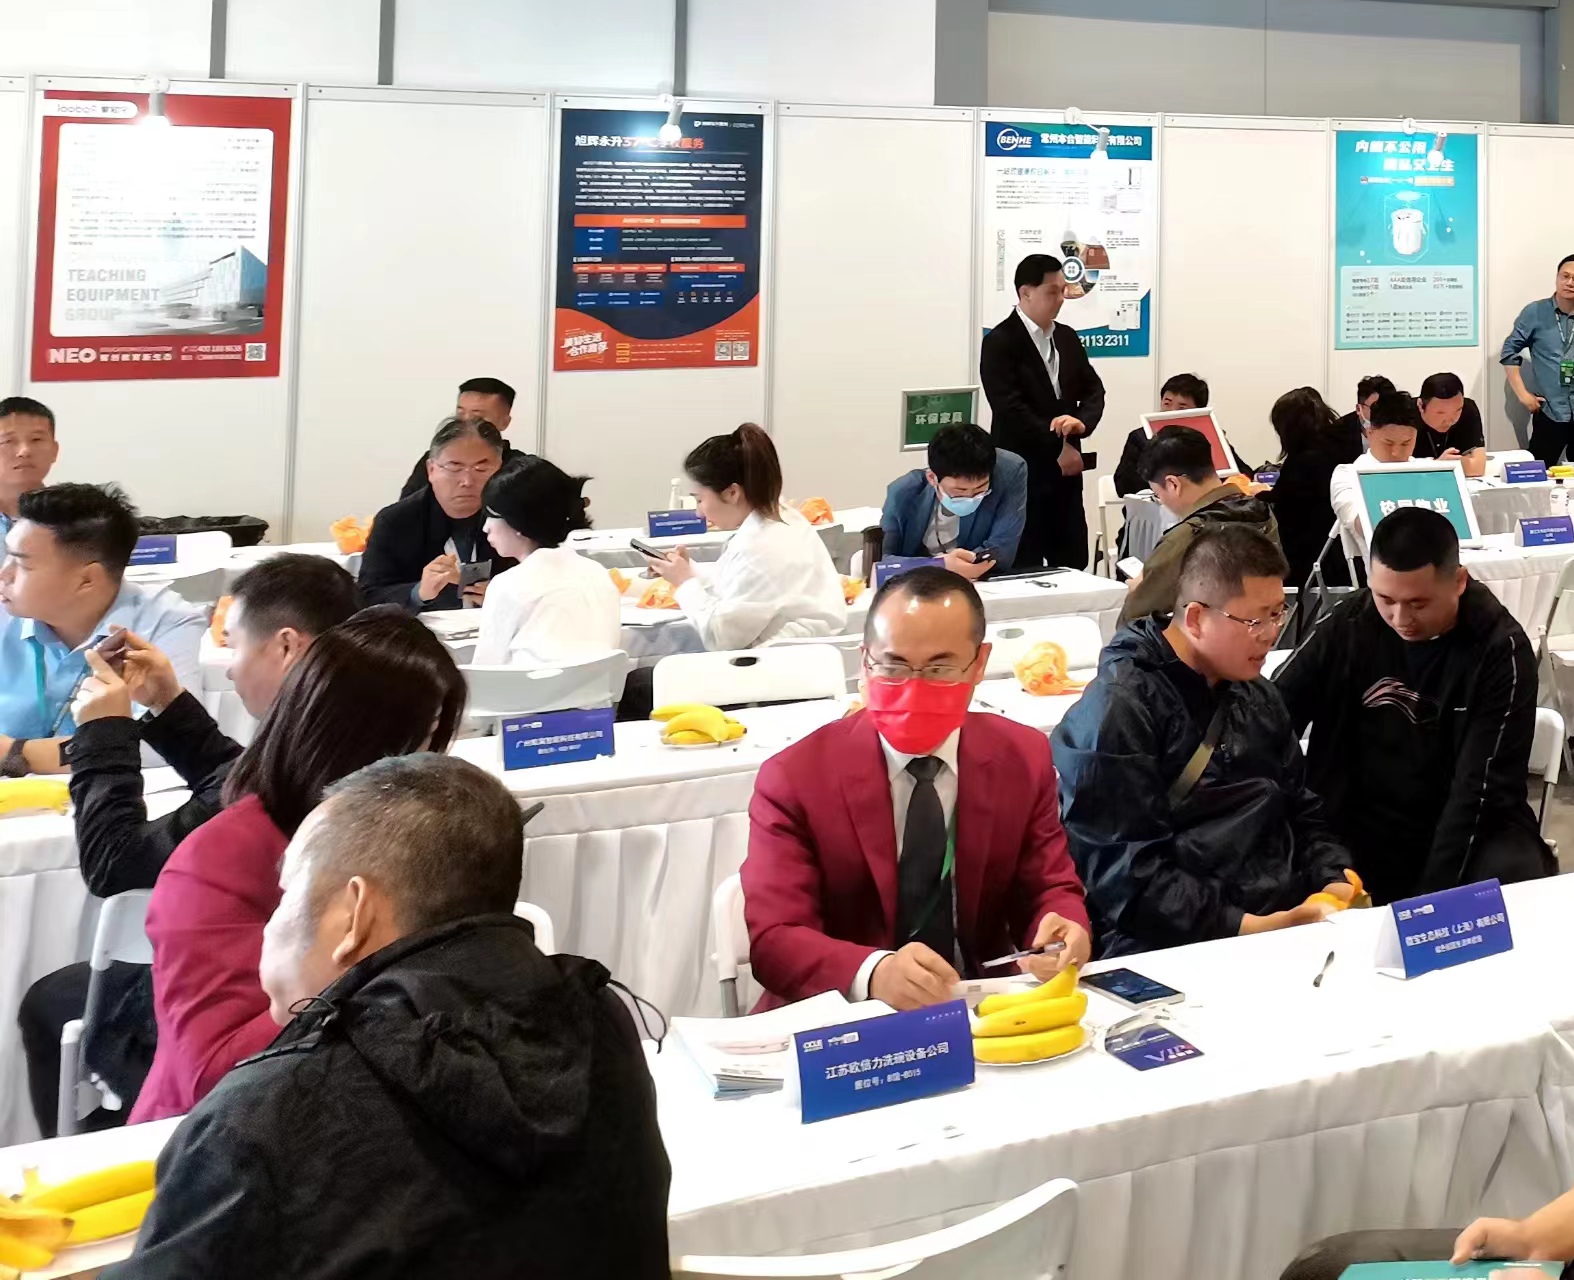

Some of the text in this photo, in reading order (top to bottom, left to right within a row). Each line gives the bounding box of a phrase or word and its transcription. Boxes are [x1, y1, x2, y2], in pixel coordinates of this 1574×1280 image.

[67, 269, 146, 281] TEACHING
[66, 288, 160, 301] EQUIPMENT
[49, 347, 97, 363] NEO
